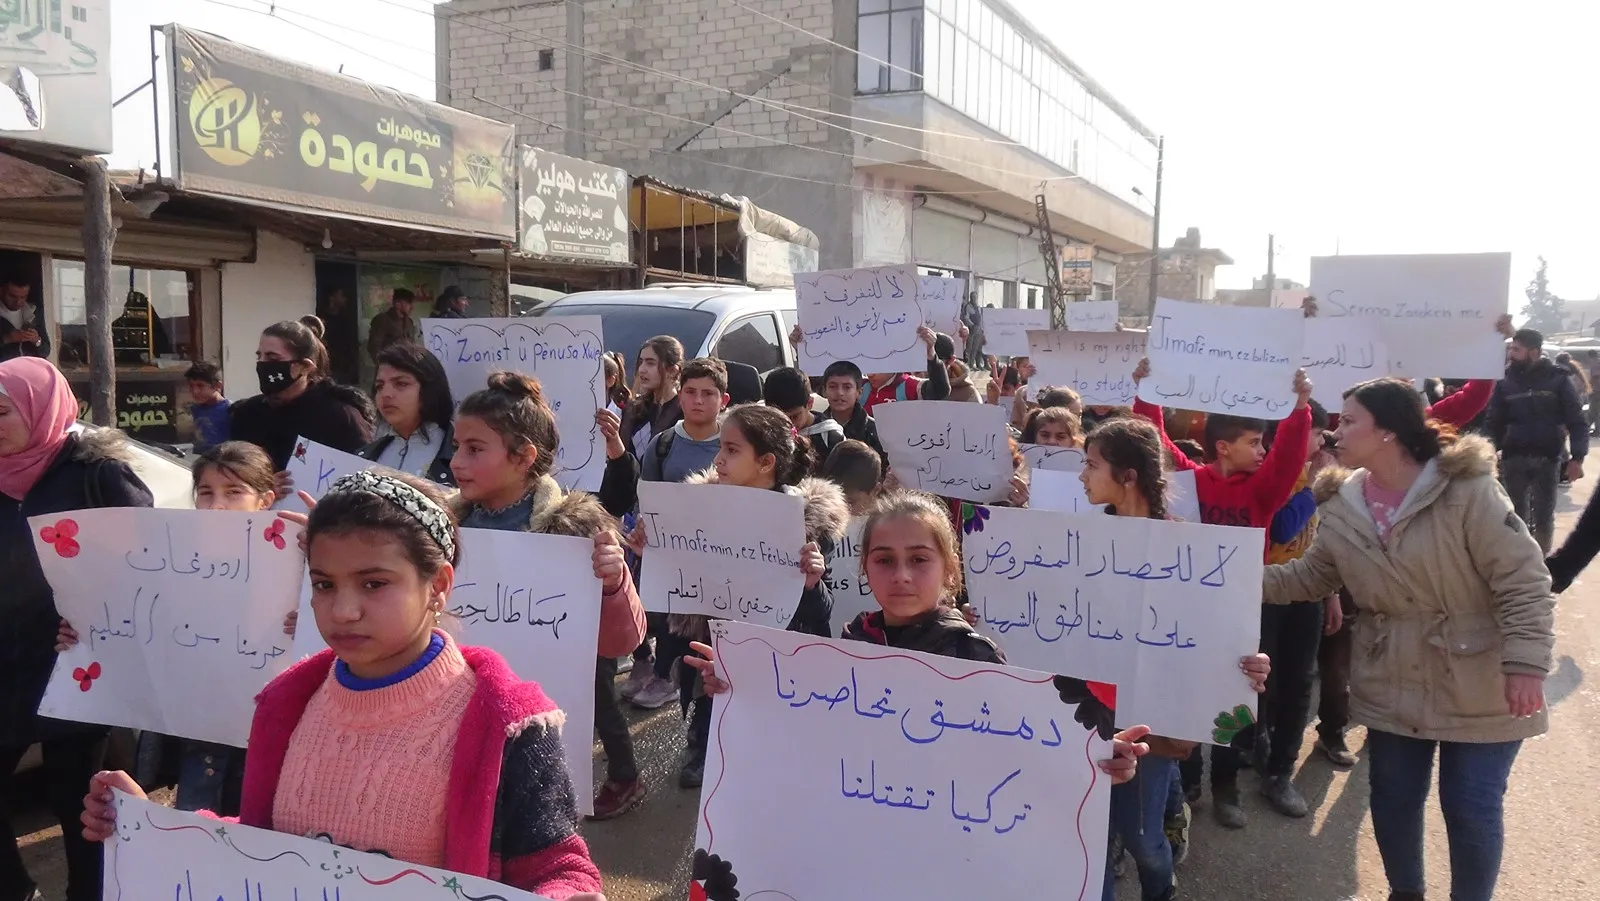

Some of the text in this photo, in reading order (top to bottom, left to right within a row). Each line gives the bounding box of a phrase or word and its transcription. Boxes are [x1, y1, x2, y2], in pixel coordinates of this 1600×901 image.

[376, 116, 441, 149] مجوهرات
[300, 110, 434, 193] حمودة
[536, 162, 617, 201] مكتب هولير
[885, 275, 904, 299] لا
[883, 313, 906, 336] نعم
[1074, 340, 1085, 351] is
[1094, 344, 1108, 363] my
[1115, 335, 1146, 362] right
[1073, 368, 1088, 390] to
[126, 394, 168, 406] مجوهرات
[118, 410, 169, 432] حمود
[970, 477, 991, 491] من
[125, 518, 252, 582] أردوغان
[741, 546, 756, 559] ez
[968, 529, 1238, 586] لا للحصار المفروض
[713, 579, 732, 610] أن
[738, 597, 773, 618] حقي
[90, 586, 286, 670] حرمنا من التعليم
[1034, 588, 1123, 642] مناطق
[1135, 605, 1196, 648] على
[773, 652, 1062, 746] دمشق تحاصرنا
[840, 758, 1031, 833] تركيا تقتلنا
